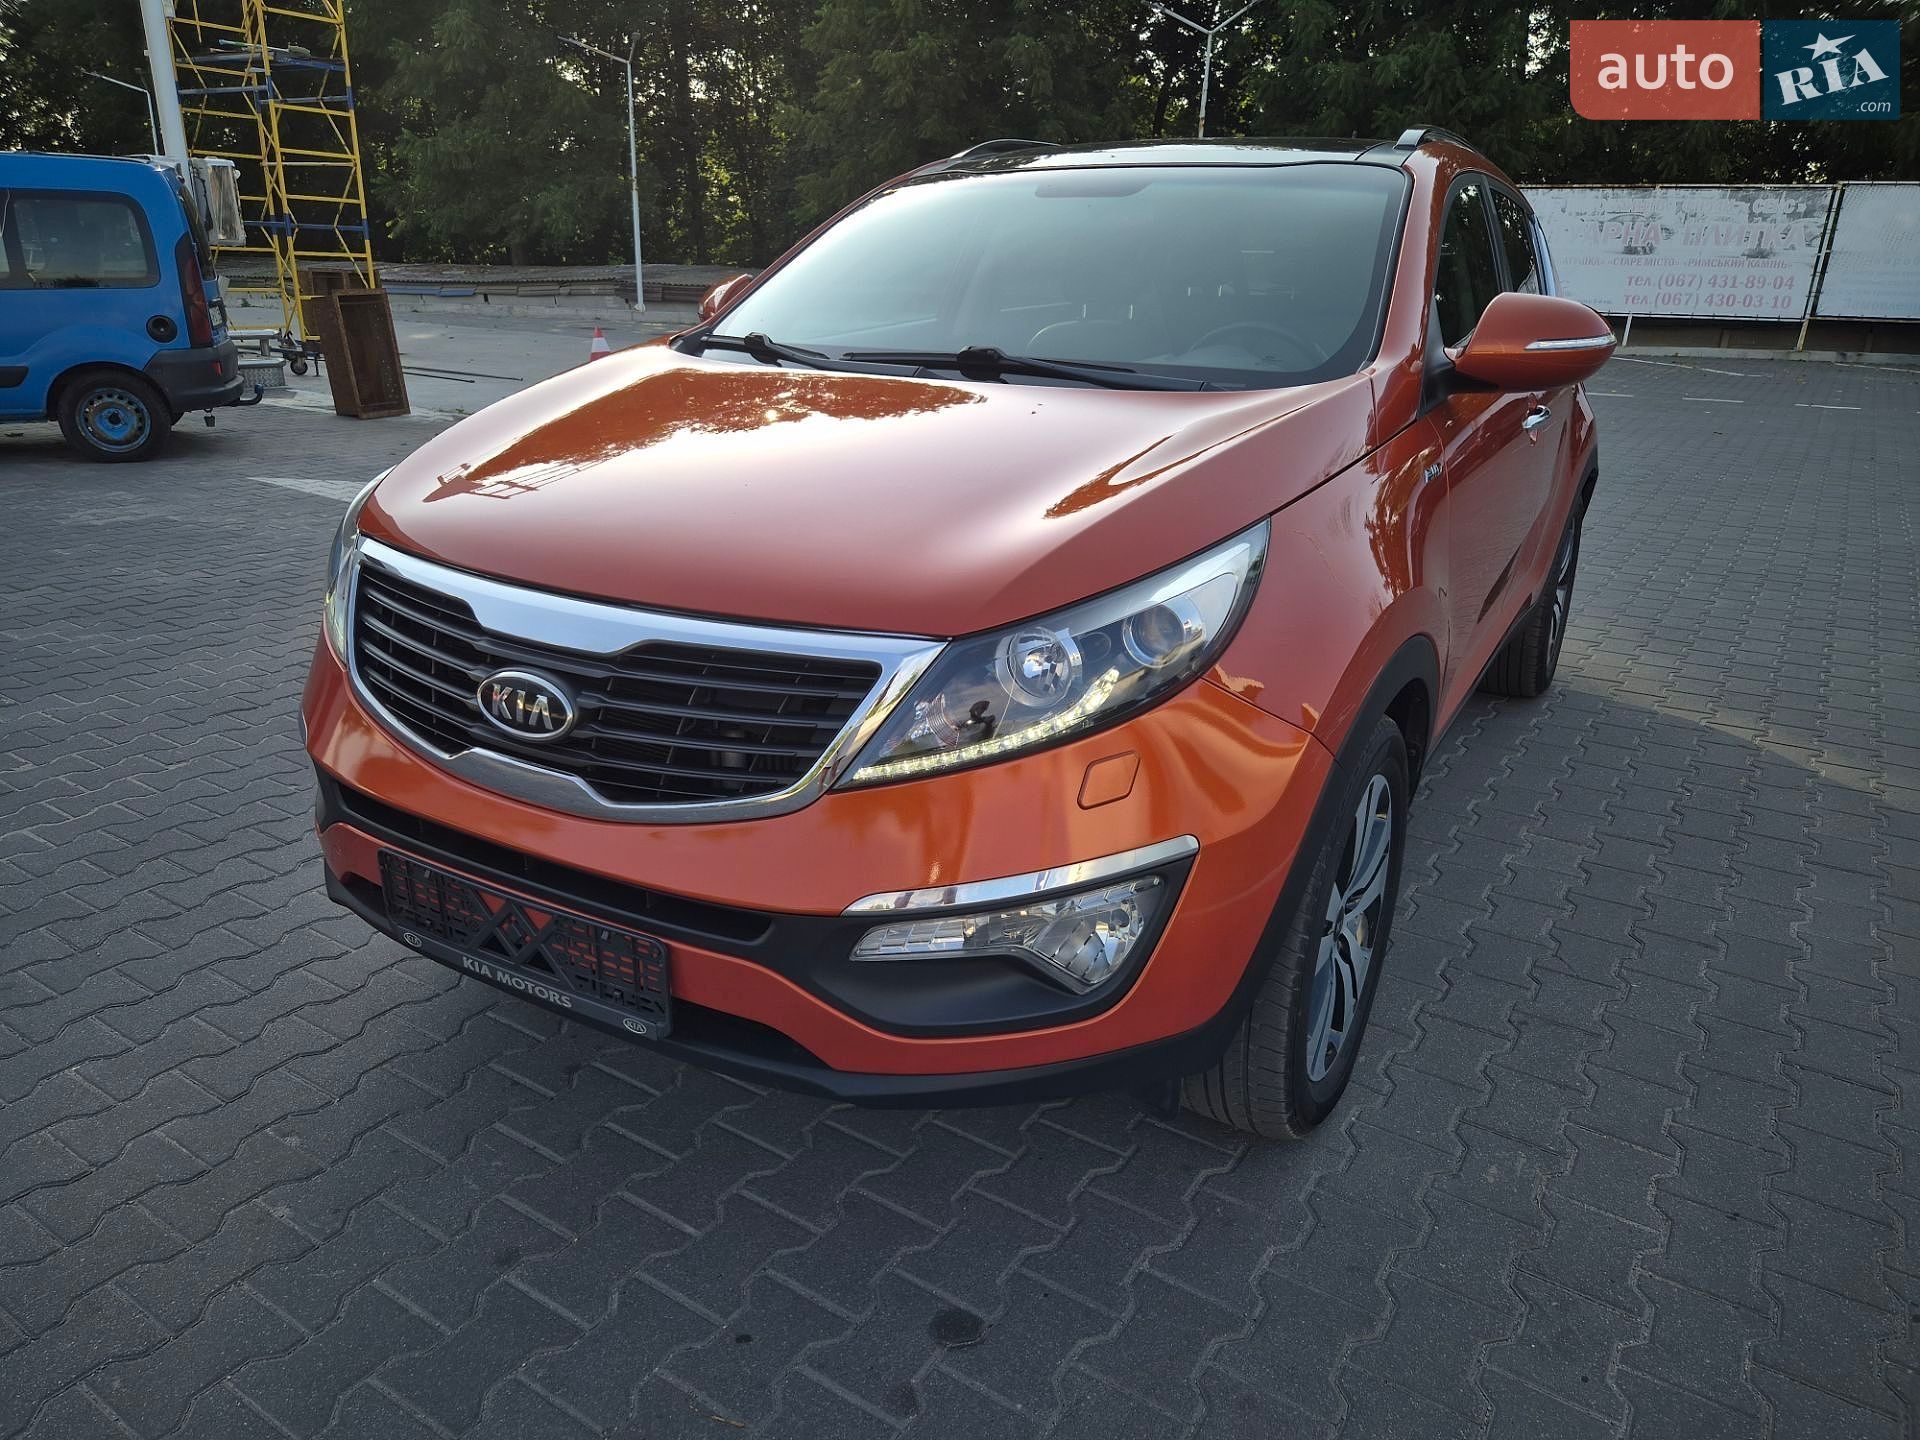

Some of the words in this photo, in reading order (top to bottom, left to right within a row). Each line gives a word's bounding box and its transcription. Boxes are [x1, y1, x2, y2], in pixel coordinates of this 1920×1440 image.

[1707, 274, 1796, 290] 431-89-04
[1703, 292, 1793, 310] 430-03-10
[491, 682, 554, 730] KIA
[462, 957, 493, 979] KIA
[497, 970, 573, 1009] MOTORS
